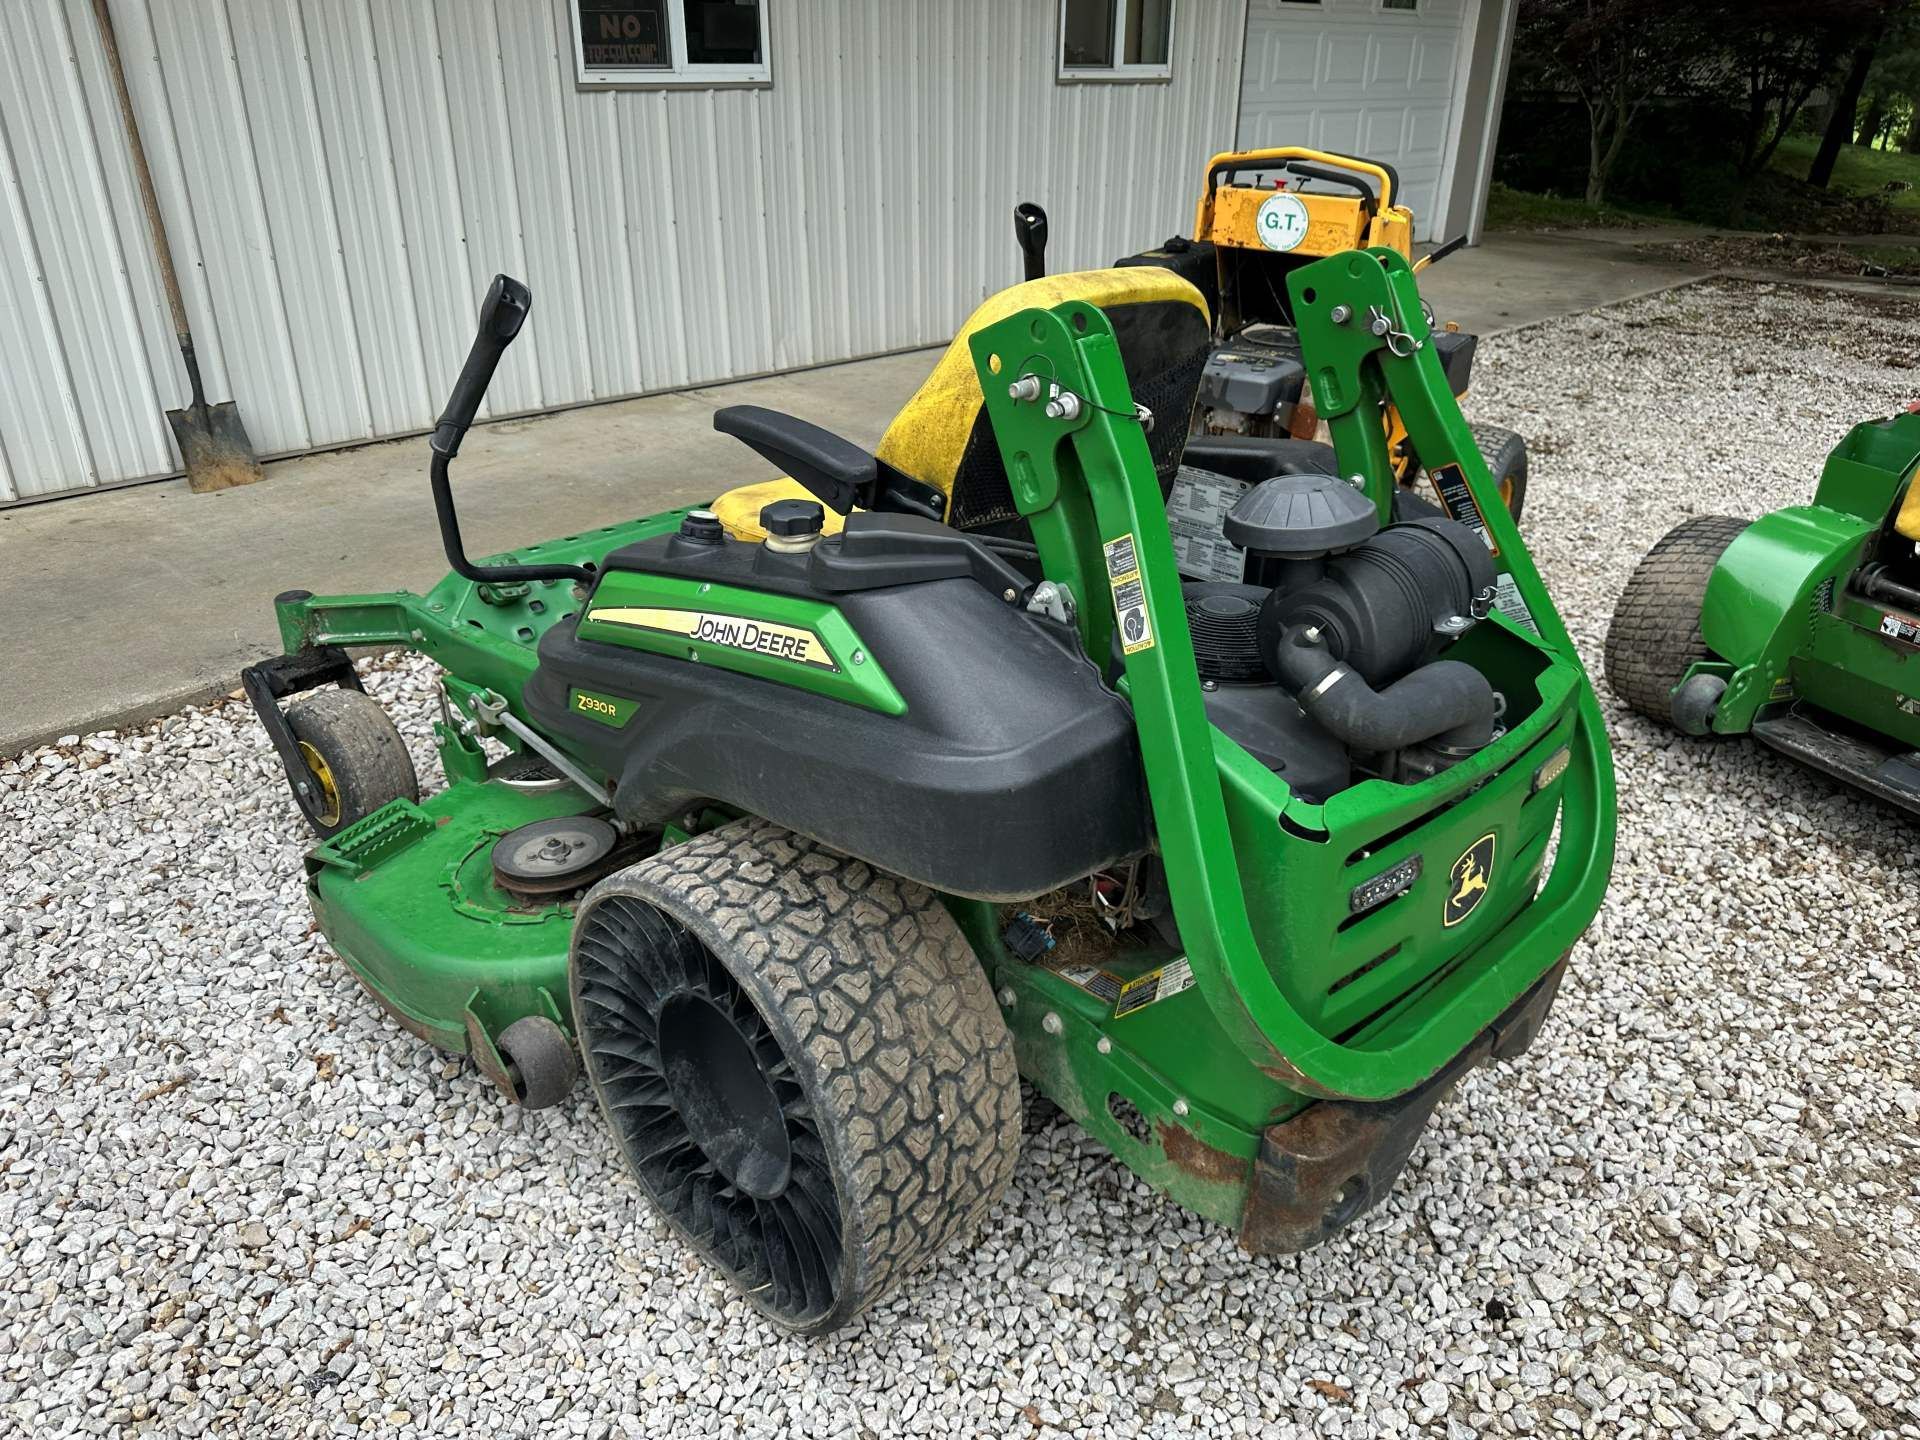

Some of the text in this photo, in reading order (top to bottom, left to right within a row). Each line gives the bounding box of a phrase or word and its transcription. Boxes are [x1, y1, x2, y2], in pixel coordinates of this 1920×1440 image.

[599, 14, 641, 39] NO
[1265, 211, 1299, 231] G.T.
[690, 615, 810, 659] JOHN DEERE
[577, 694, 616, 717] Z930R
